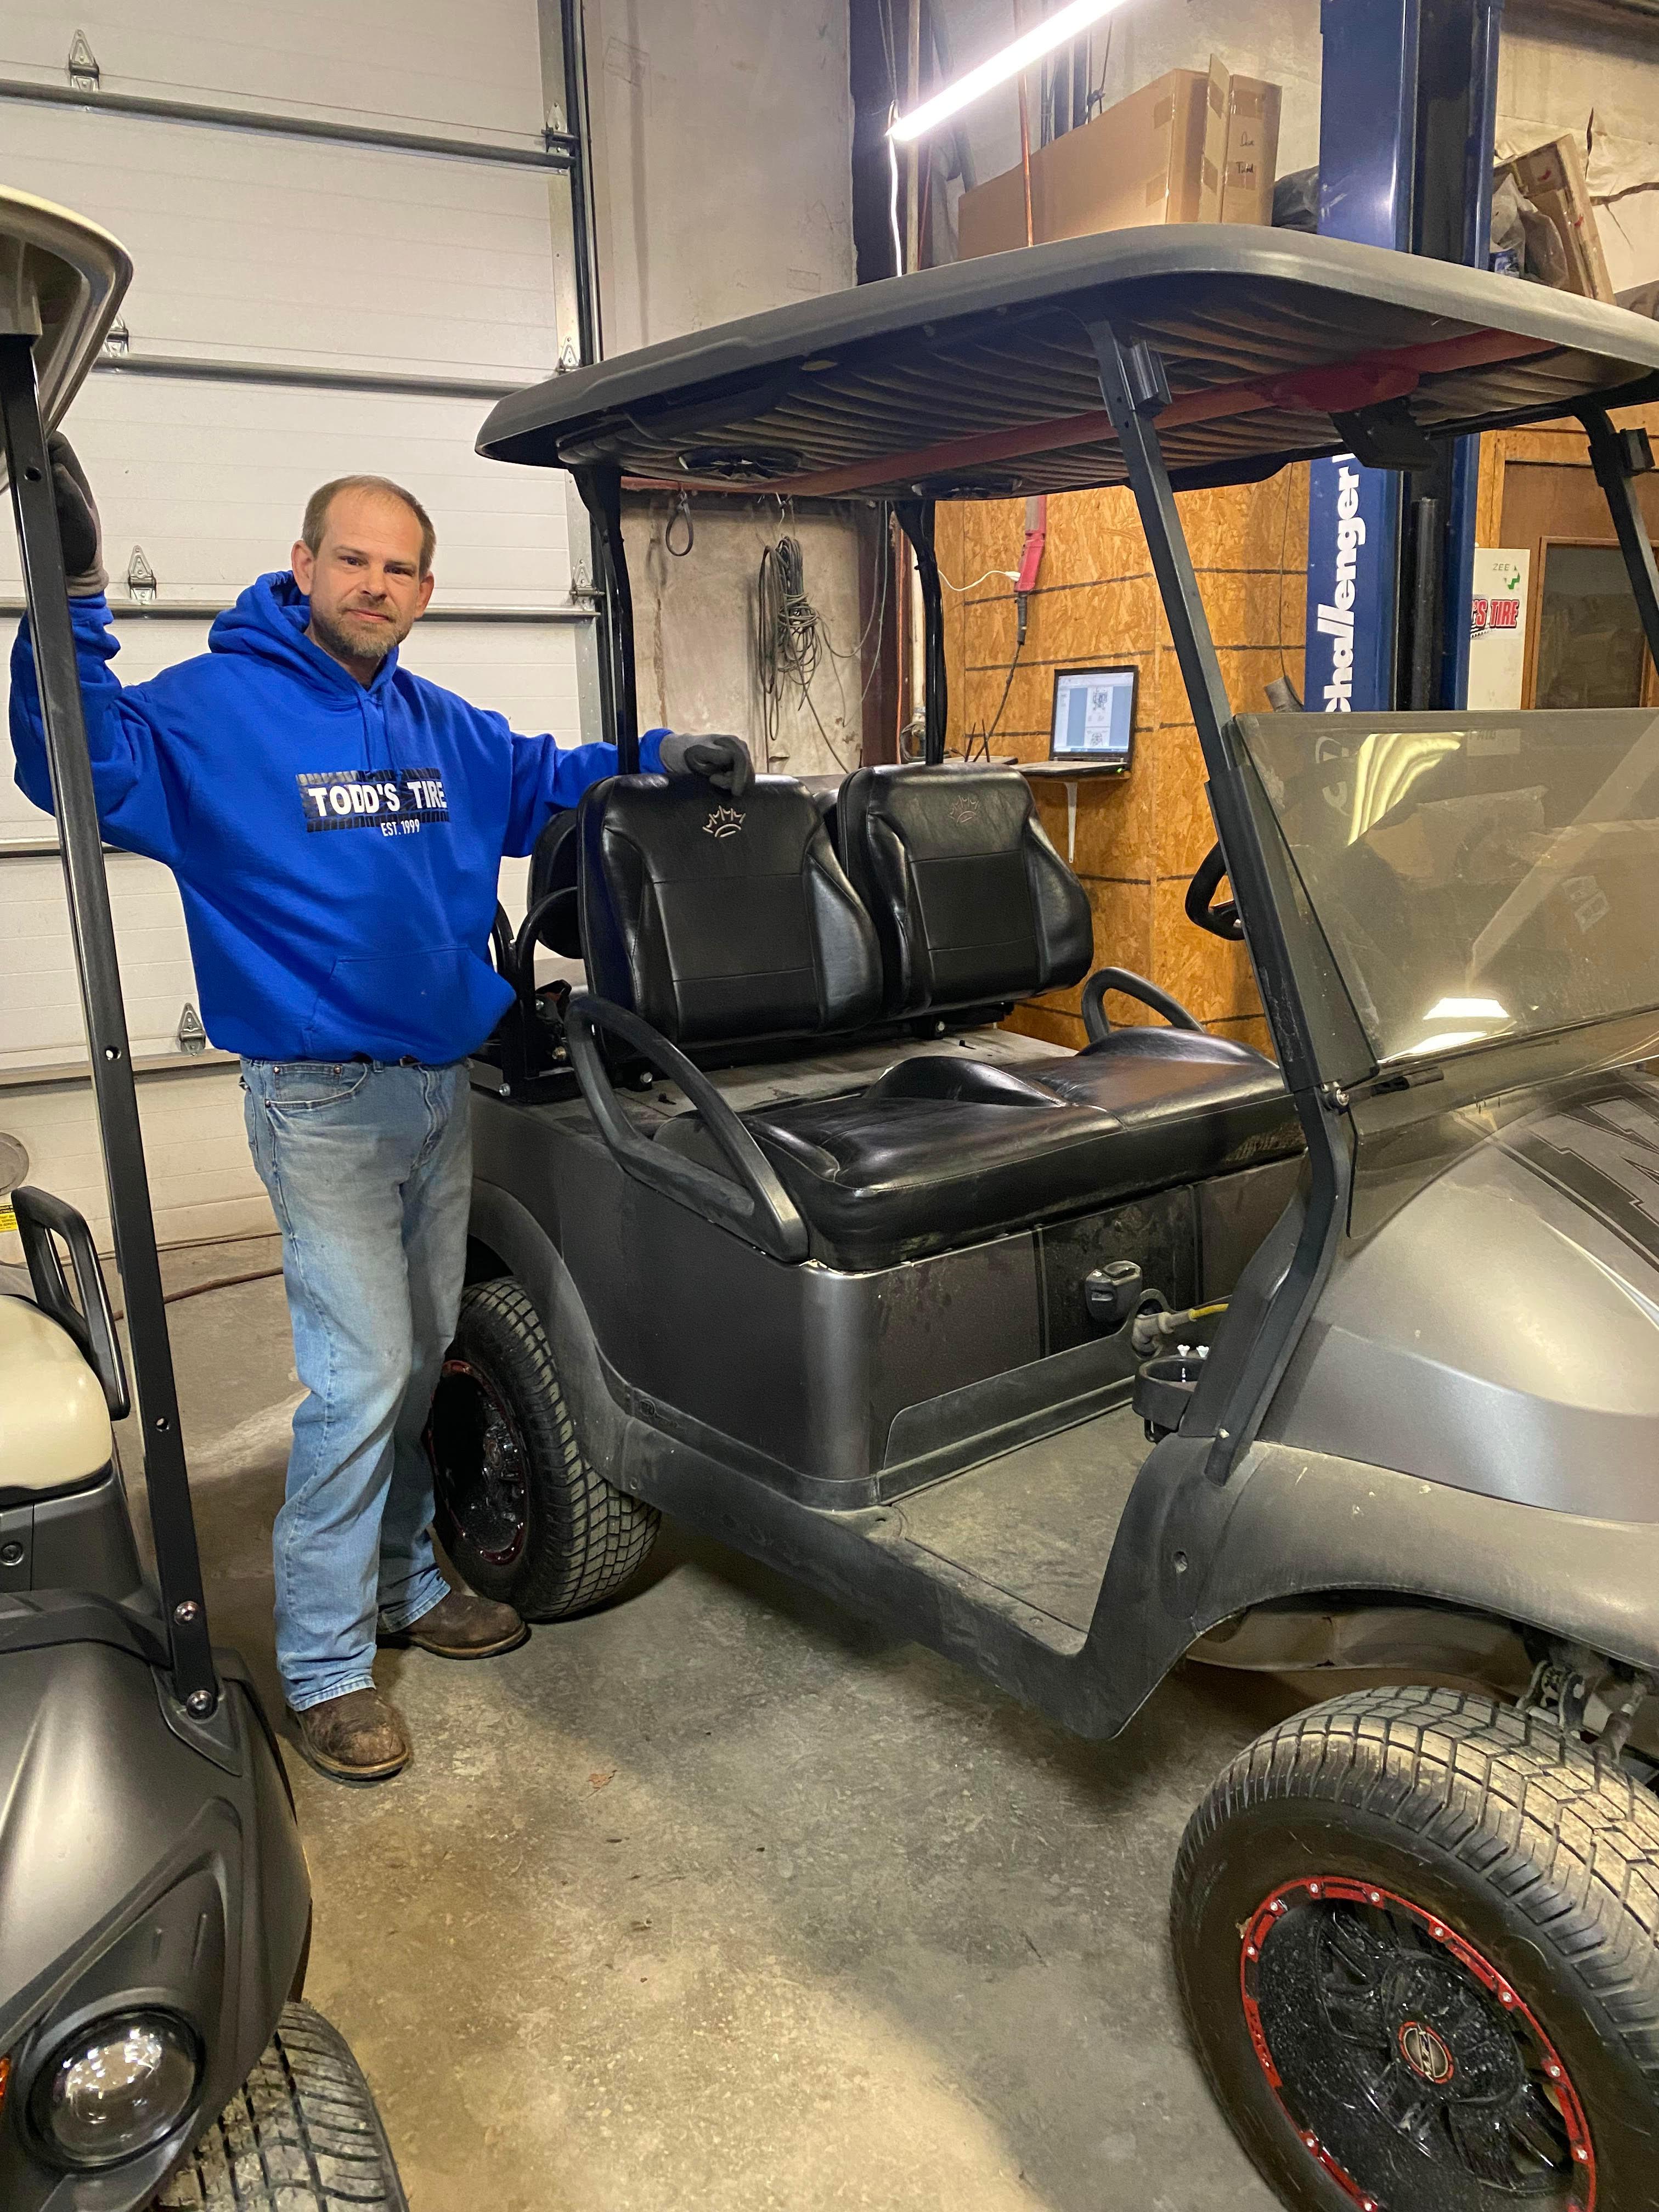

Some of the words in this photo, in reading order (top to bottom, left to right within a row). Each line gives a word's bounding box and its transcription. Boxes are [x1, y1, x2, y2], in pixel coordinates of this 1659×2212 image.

[1489, 599, 1520, 629] TIRE
[308, 783, 400, 816] TODD'S
[407, 781, 447, 809] TIRE
[380, 822, 401, 837] EST.
[401, 819, 420, 834] 1999
